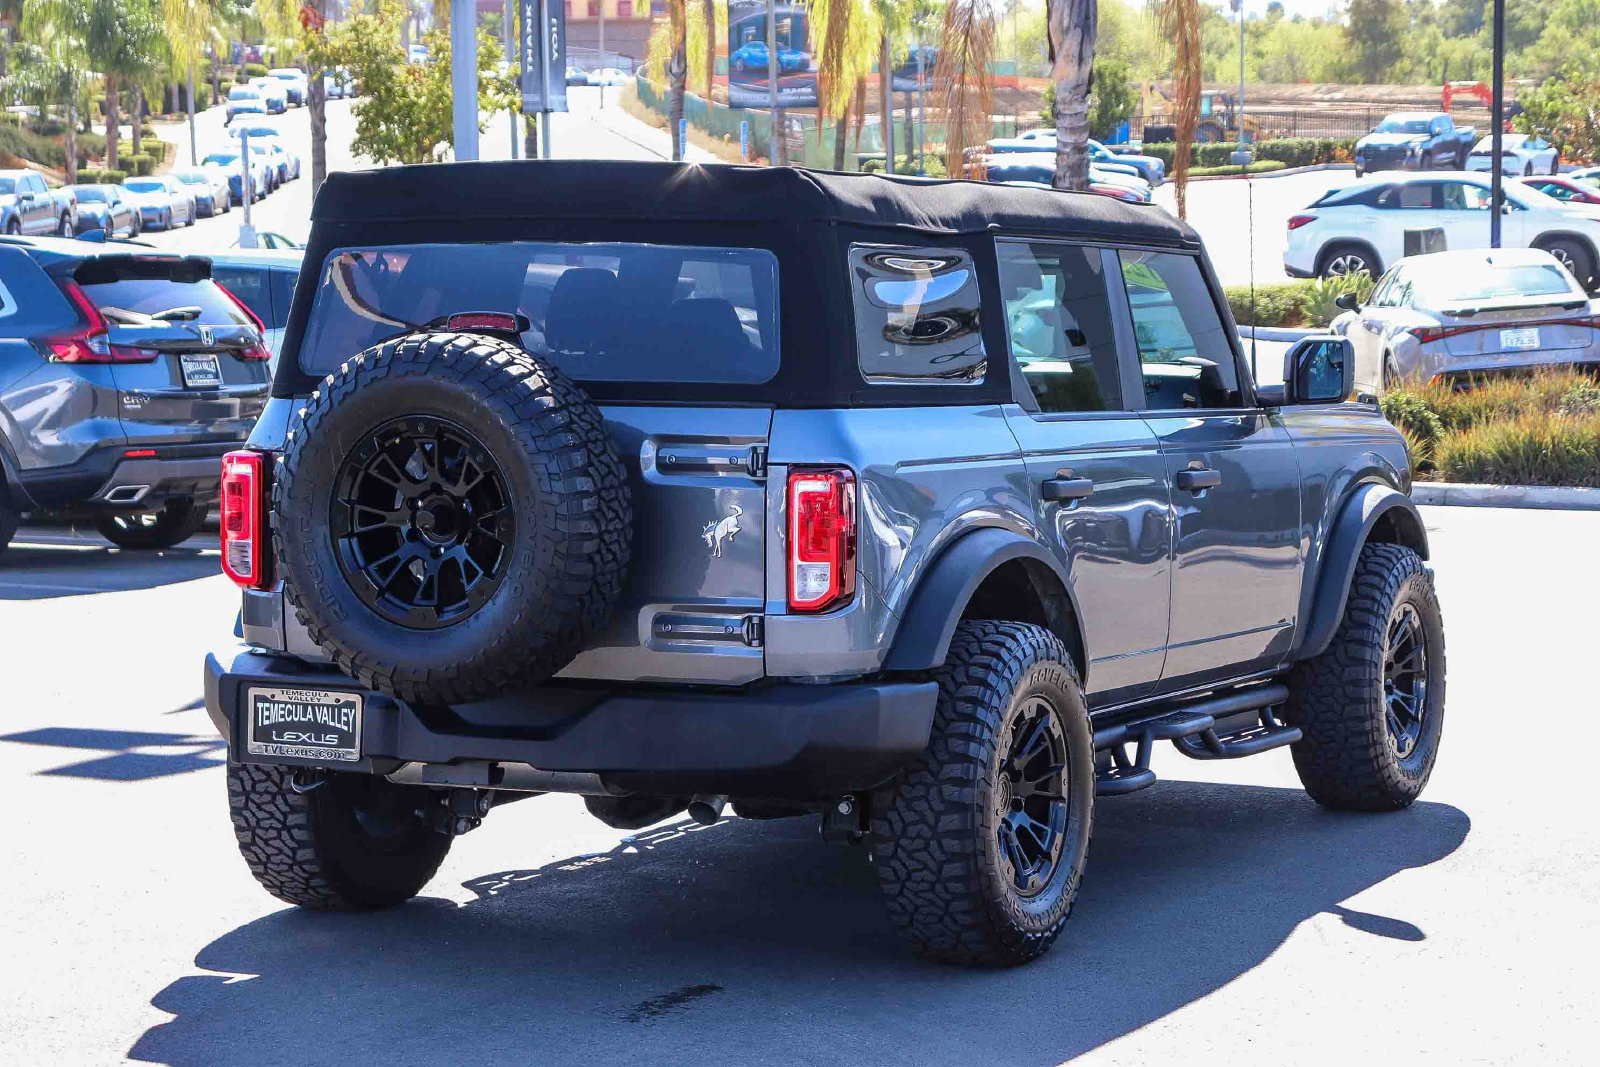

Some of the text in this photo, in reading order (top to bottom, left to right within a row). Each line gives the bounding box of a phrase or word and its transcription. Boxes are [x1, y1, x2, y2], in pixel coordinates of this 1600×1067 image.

[1030, 667, 1068, 693] ROVELO
[280, 690, 329, 698] TEMECULA
[288, 695, 321, 703] VALLEY
[257, 702, 355, 733] TEMECULA VALLEY
[272, 730, 339, 745] LEXUS
[262, 744, 345, 759] TVLexus.com
